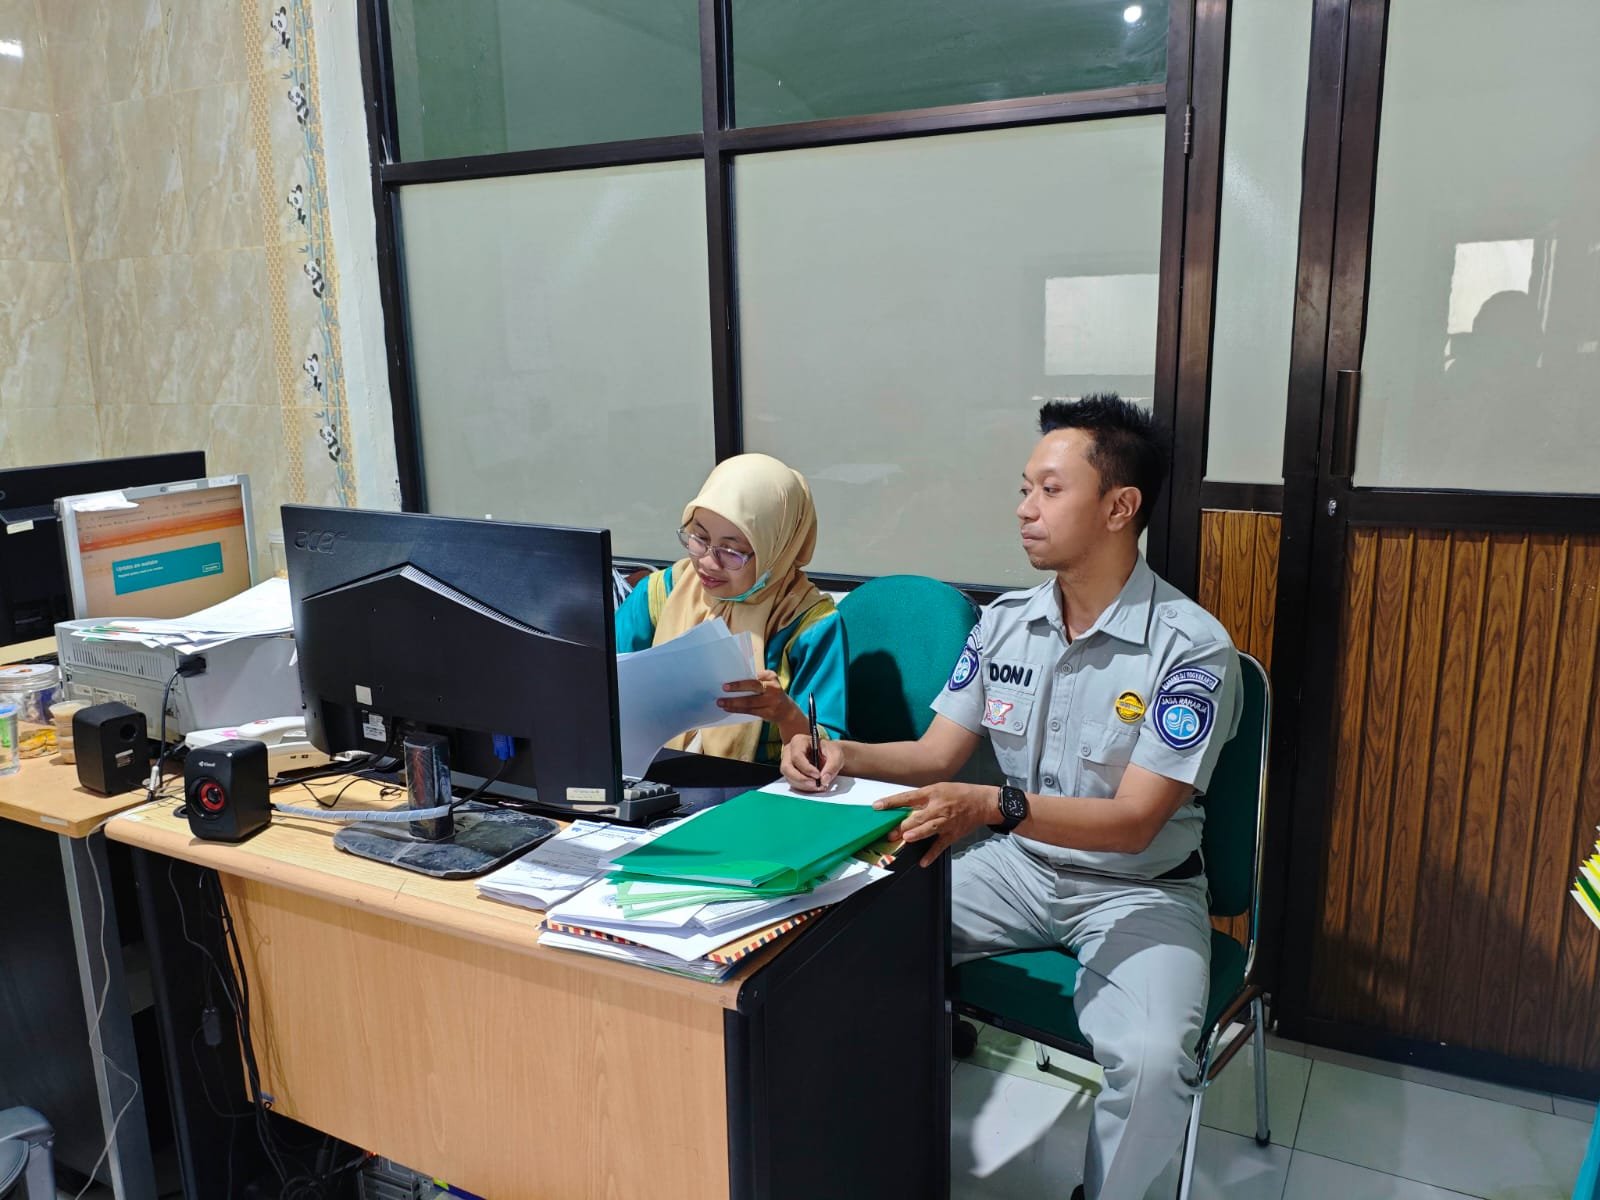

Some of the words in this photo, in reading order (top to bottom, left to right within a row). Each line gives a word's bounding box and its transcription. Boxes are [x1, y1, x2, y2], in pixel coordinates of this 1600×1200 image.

[294, 528, 347, 555] acer
[990, 663, 1033, 687] DONI
[1161, 697, 1178, 705] JASA
[1180, 697, 1208, 713] RAHARJA
